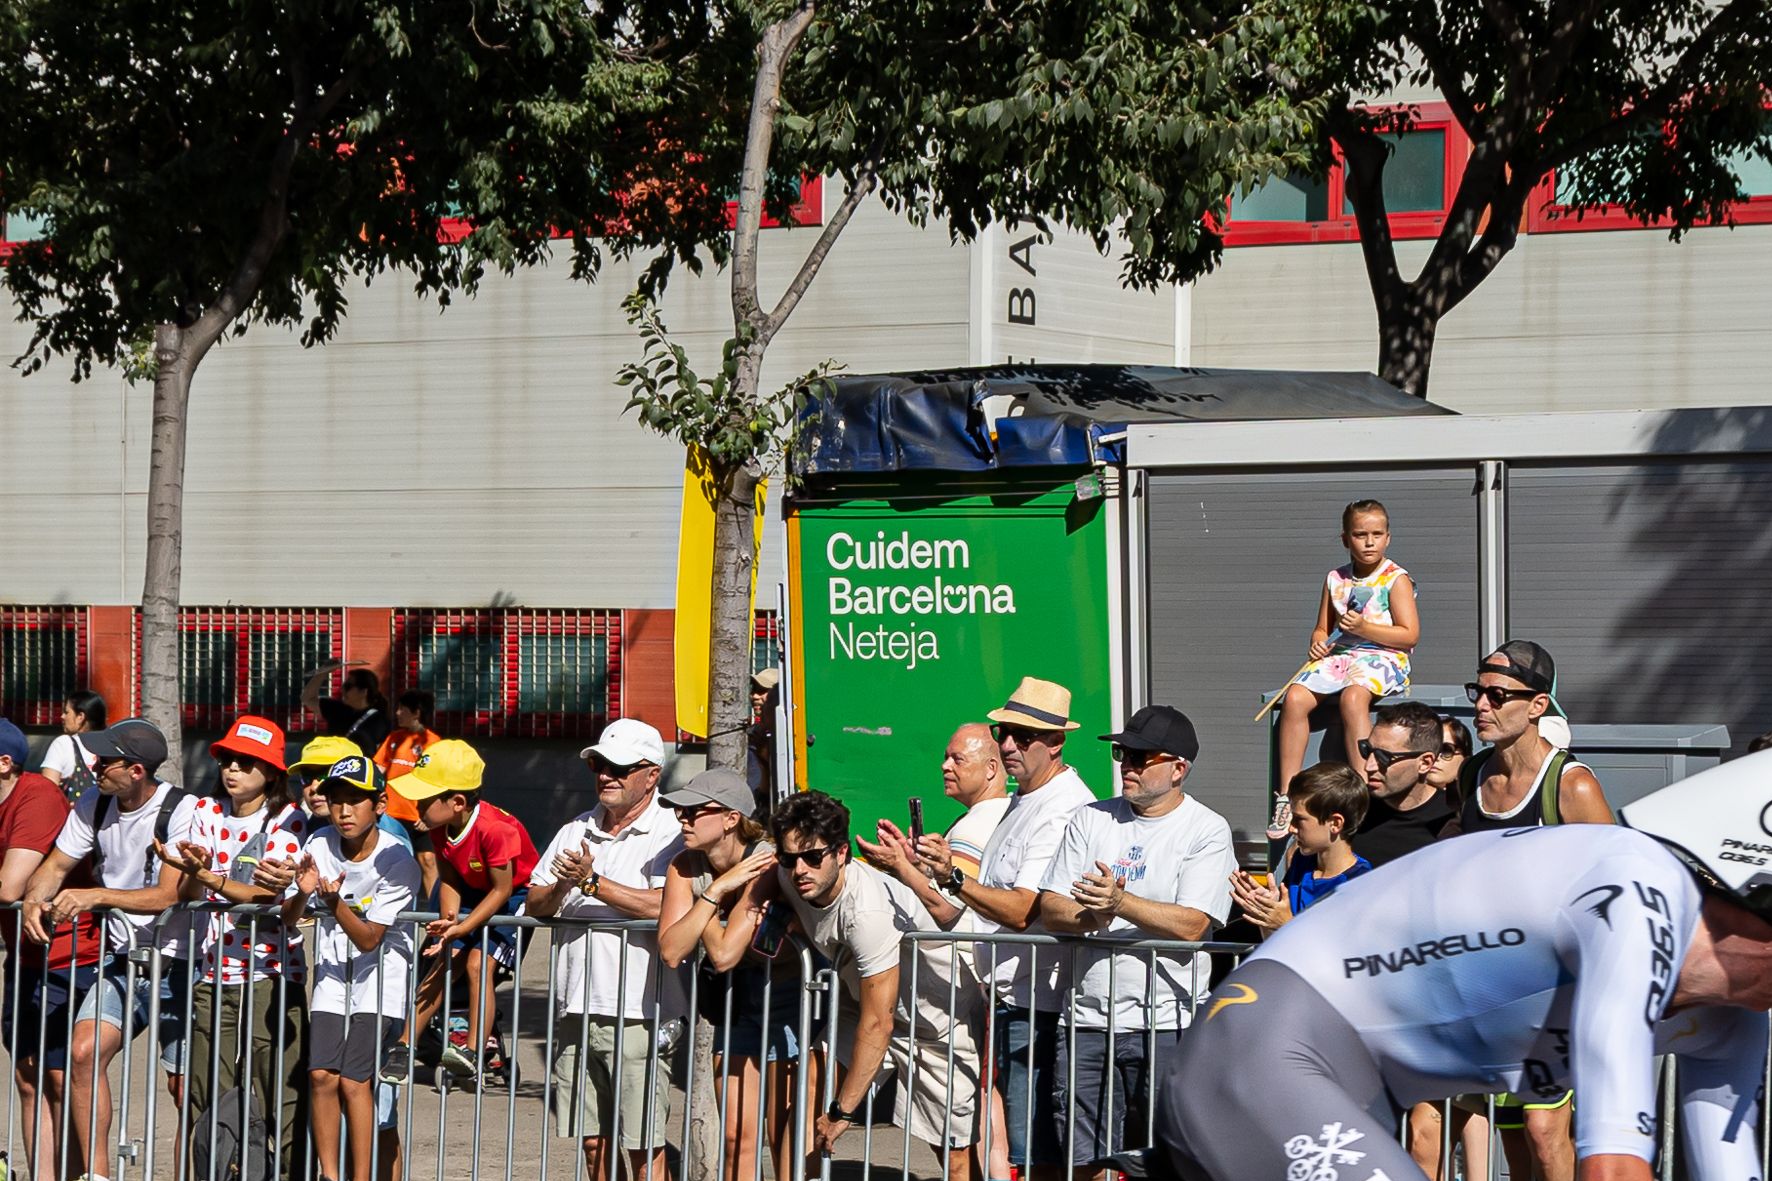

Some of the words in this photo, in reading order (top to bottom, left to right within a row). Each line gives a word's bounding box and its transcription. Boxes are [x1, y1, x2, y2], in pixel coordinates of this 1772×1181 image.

[1007, 217, 1037, 325] BA
[826, 531, 969, 570] Cuidem
[829, 576, 1016, 614] Barcelona
[829, 622, 940, 669] Neteja
[1718, 851, 1768, 866] Q36.5
[1343, 927, 1526, 979] PINARELLO
